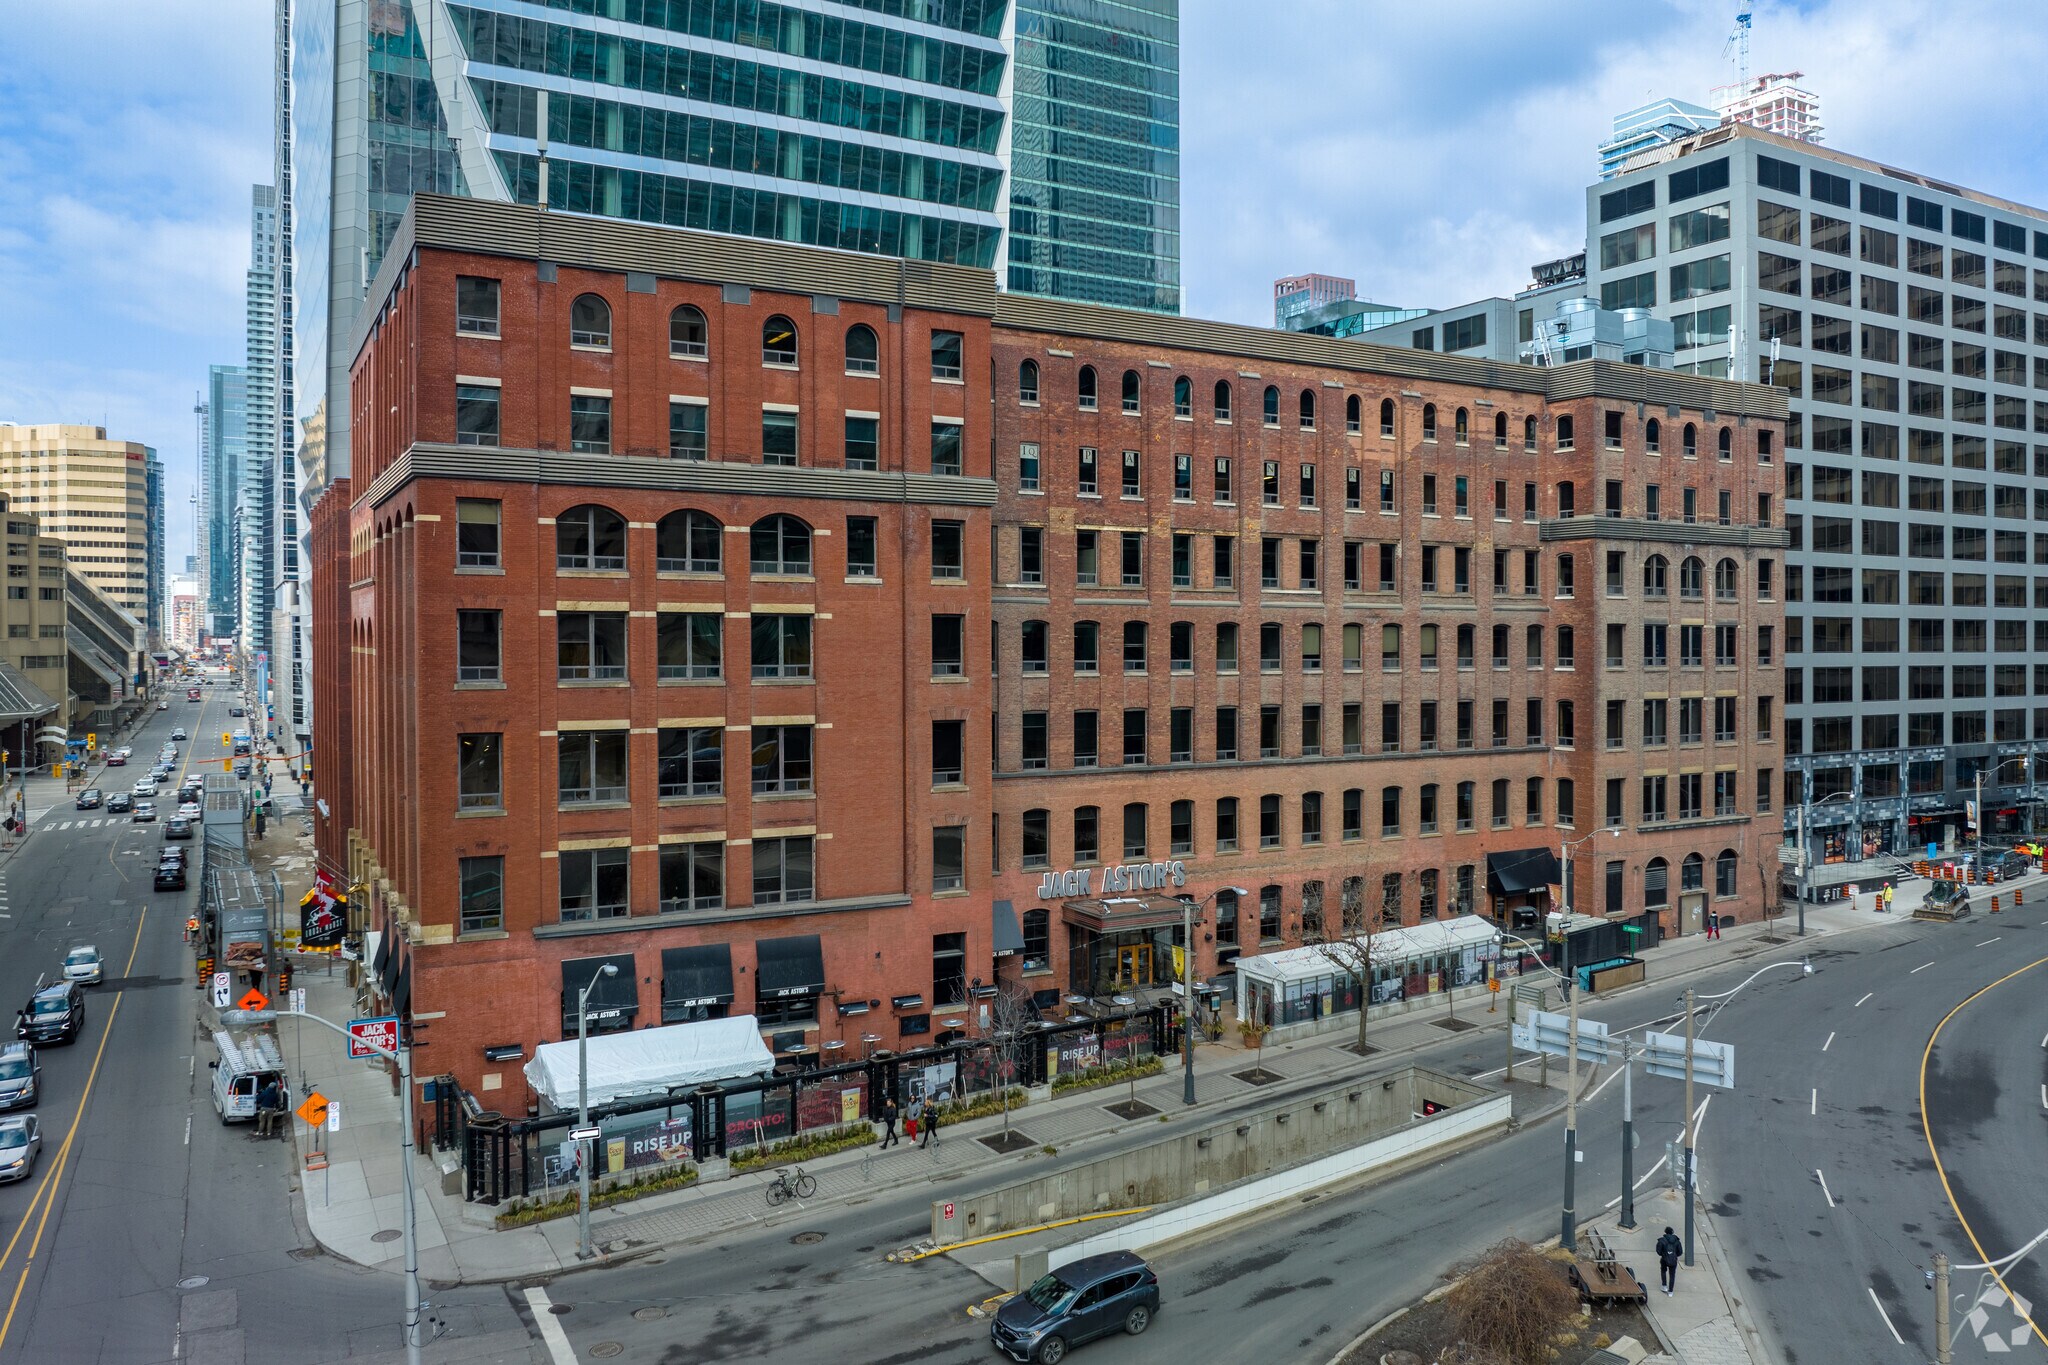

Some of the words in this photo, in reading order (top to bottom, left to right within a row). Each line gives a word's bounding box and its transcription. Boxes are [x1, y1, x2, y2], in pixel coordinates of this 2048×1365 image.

[1037, 869, 1091, 899] JACK
[1102, 861, 1185, 893] ASTOR'S
[790, 986, 809, 995] ASTOR'S
[697, 997, 717, 1005] ASTOR'S
[585, 1012, 599, 1020] JACK
[600, 1010, 620, 1019] ASTOR'S
[361, 1023, 387, 1036] JACK
[1062, 1048, 1084, 1061] RISE
[1086, 1044, 1100, 1056] UP
[726, 1112, 785, 1133] ORONTO!
[633, 1135, 668, 1154] RISE
[671, 1131, 693, 1147] UP
